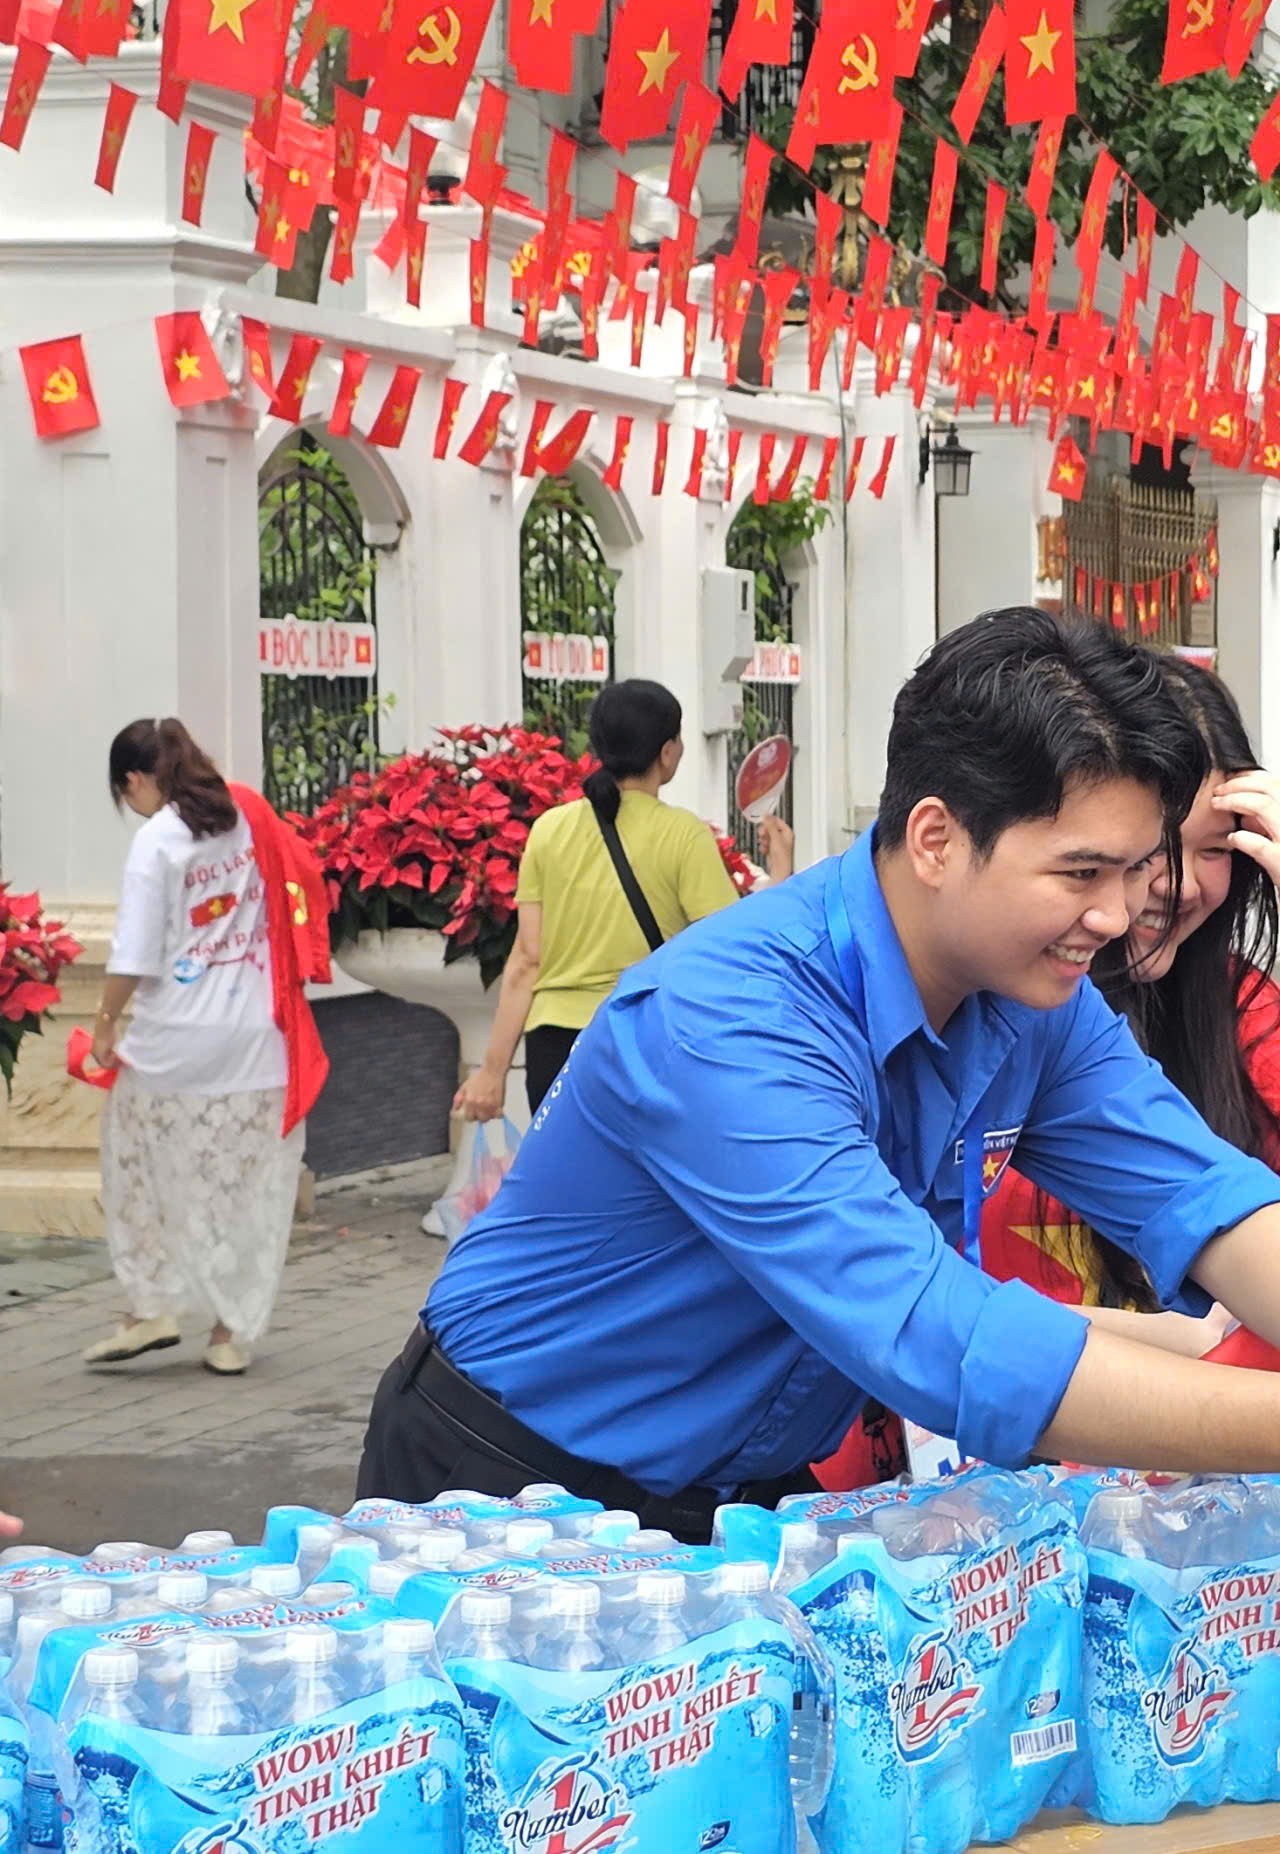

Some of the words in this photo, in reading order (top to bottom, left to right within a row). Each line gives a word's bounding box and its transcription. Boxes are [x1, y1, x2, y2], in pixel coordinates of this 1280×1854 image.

[951, 1545, 1019, 1603] WOW!
[1203, 1605, 1262, 1641] TINH
[604, 1710, 671, 1758] TINH
[684, 1664, 763, 1727] KHIẾT
[605, 1665, 695, 1722] WOW!
[891, 1662, 966, 1719] Number
[254, 1774, 332, 1826] TINH
[345, 1723, 436, 1788] KHIẾT
[255, 1725, 356, 1789] WOW!
[649, 1720, 716, 1773] THẬT
[307, 1785, 382, 1840] THẬT
[503, 1783, 621, 1848] Number
